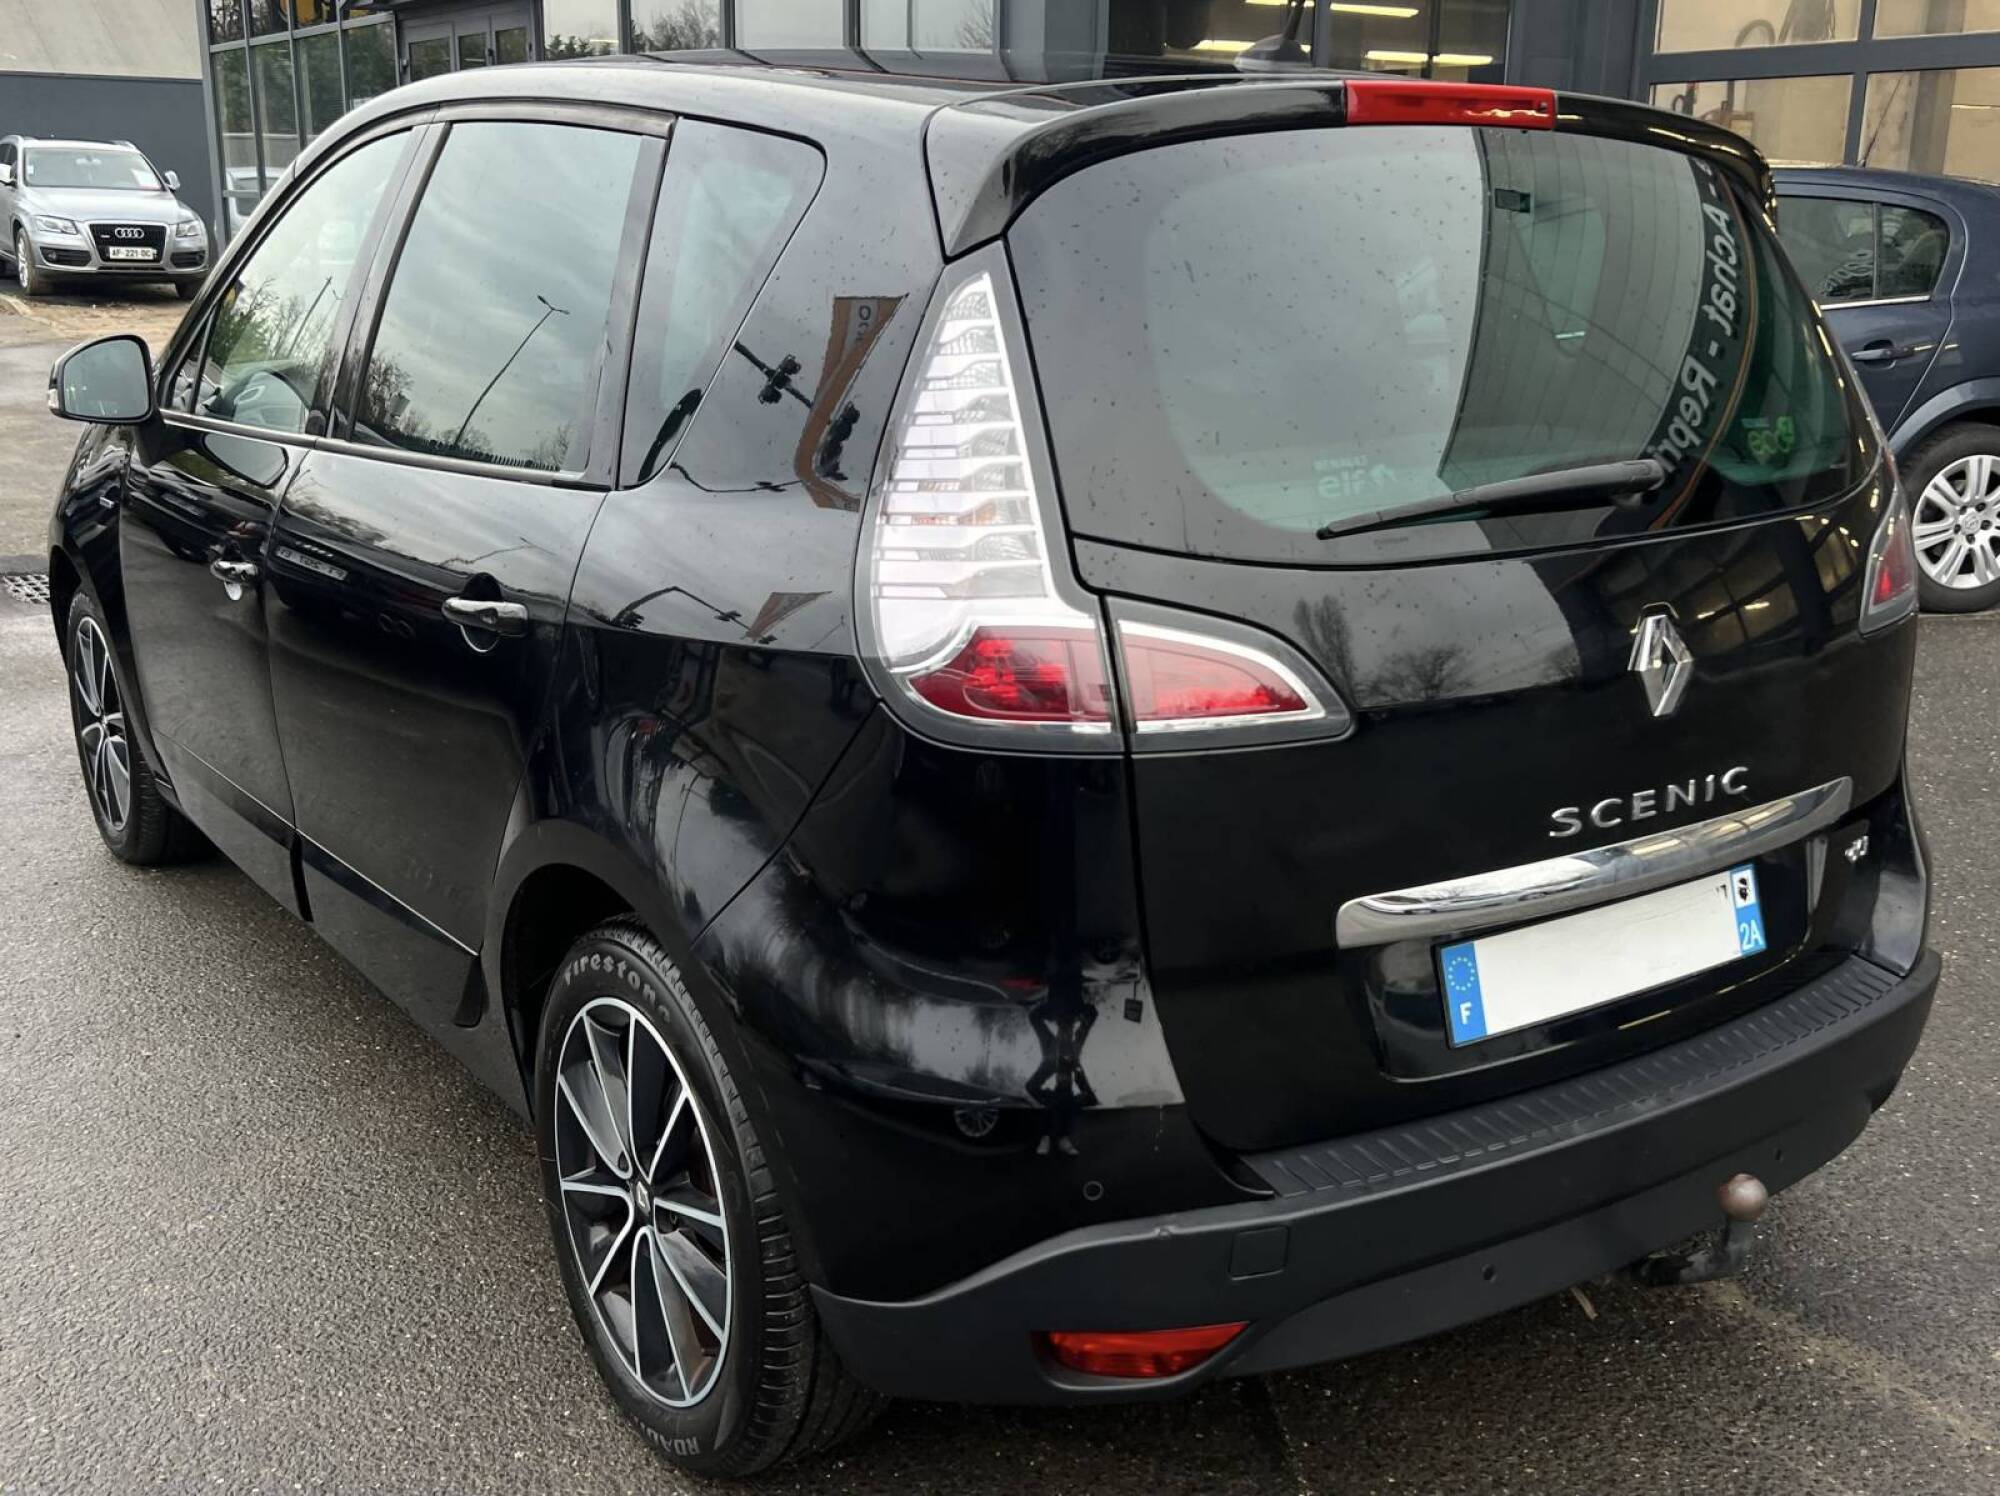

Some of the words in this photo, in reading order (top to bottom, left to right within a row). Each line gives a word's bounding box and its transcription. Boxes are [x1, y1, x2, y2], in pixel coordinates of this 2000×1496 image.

[1318, 469, 1365, 497] elf
[1548, 766, 1749, 838] SCENIC
[1739, 919, 1764, 950] 2A
[1459, 1001, 1472, 1025] F
